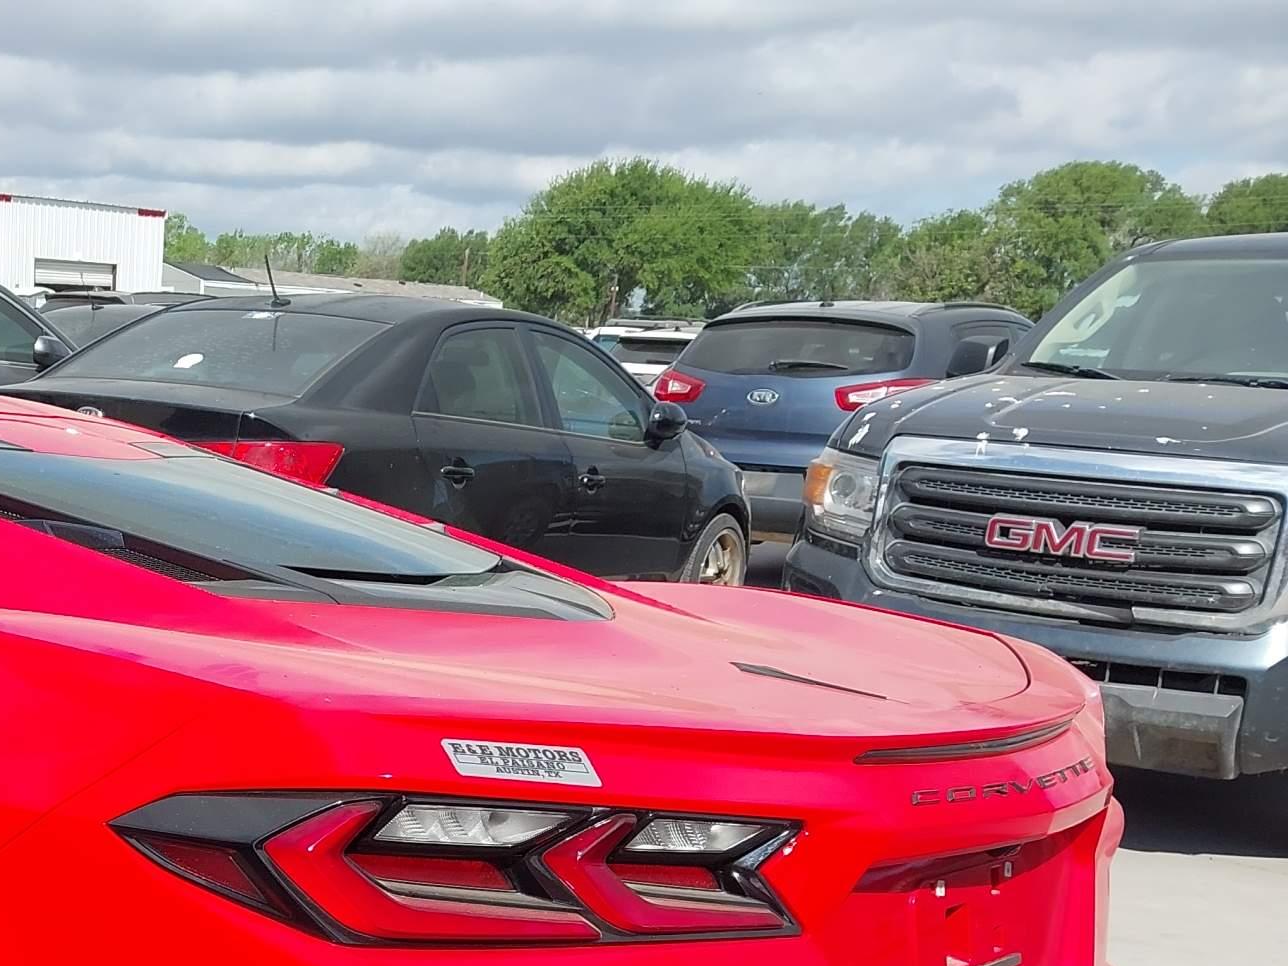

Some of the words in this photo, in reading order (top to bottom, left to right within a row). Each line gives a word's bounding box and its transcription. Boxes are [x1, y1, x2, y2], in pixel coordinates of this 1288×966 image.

[985, 513, 1144, 563] GMC
[448, 742, 493, 756] E&E
[495, 745, 582, 763] MOTORS
[480, 756, 499, 766] EL
[502, 758, 566, 771] PAISANO
[911, 756, 1097, 806] CORVETTE
